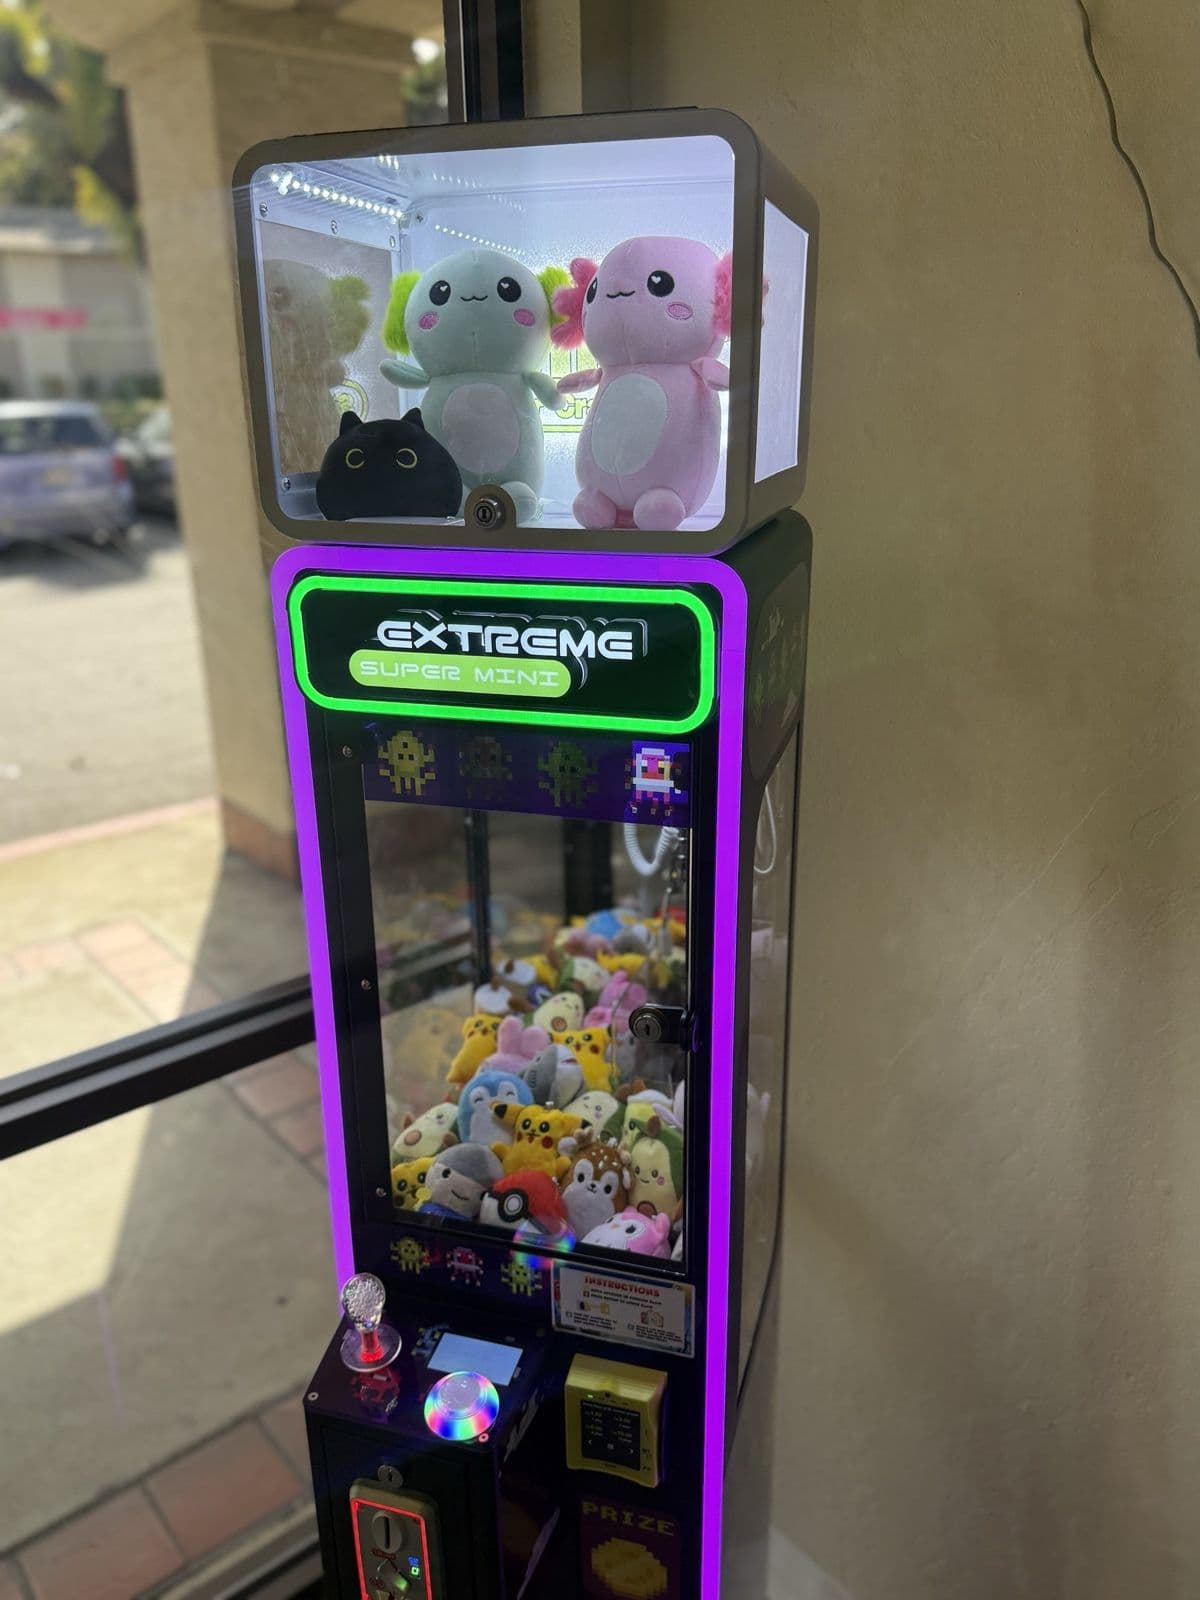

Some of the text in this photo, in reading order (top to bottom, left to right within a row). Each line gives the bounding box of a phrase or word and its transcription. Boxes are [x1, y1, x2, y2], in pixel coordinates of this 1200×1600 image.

[376, 618, 634, 661] EXTREME
[360, 660, 560, 687] SUPER MINI
[583, 1275, 660, 1297] INSTRUCTIONS
[580, 1500, 675, 1537] PRIZE
